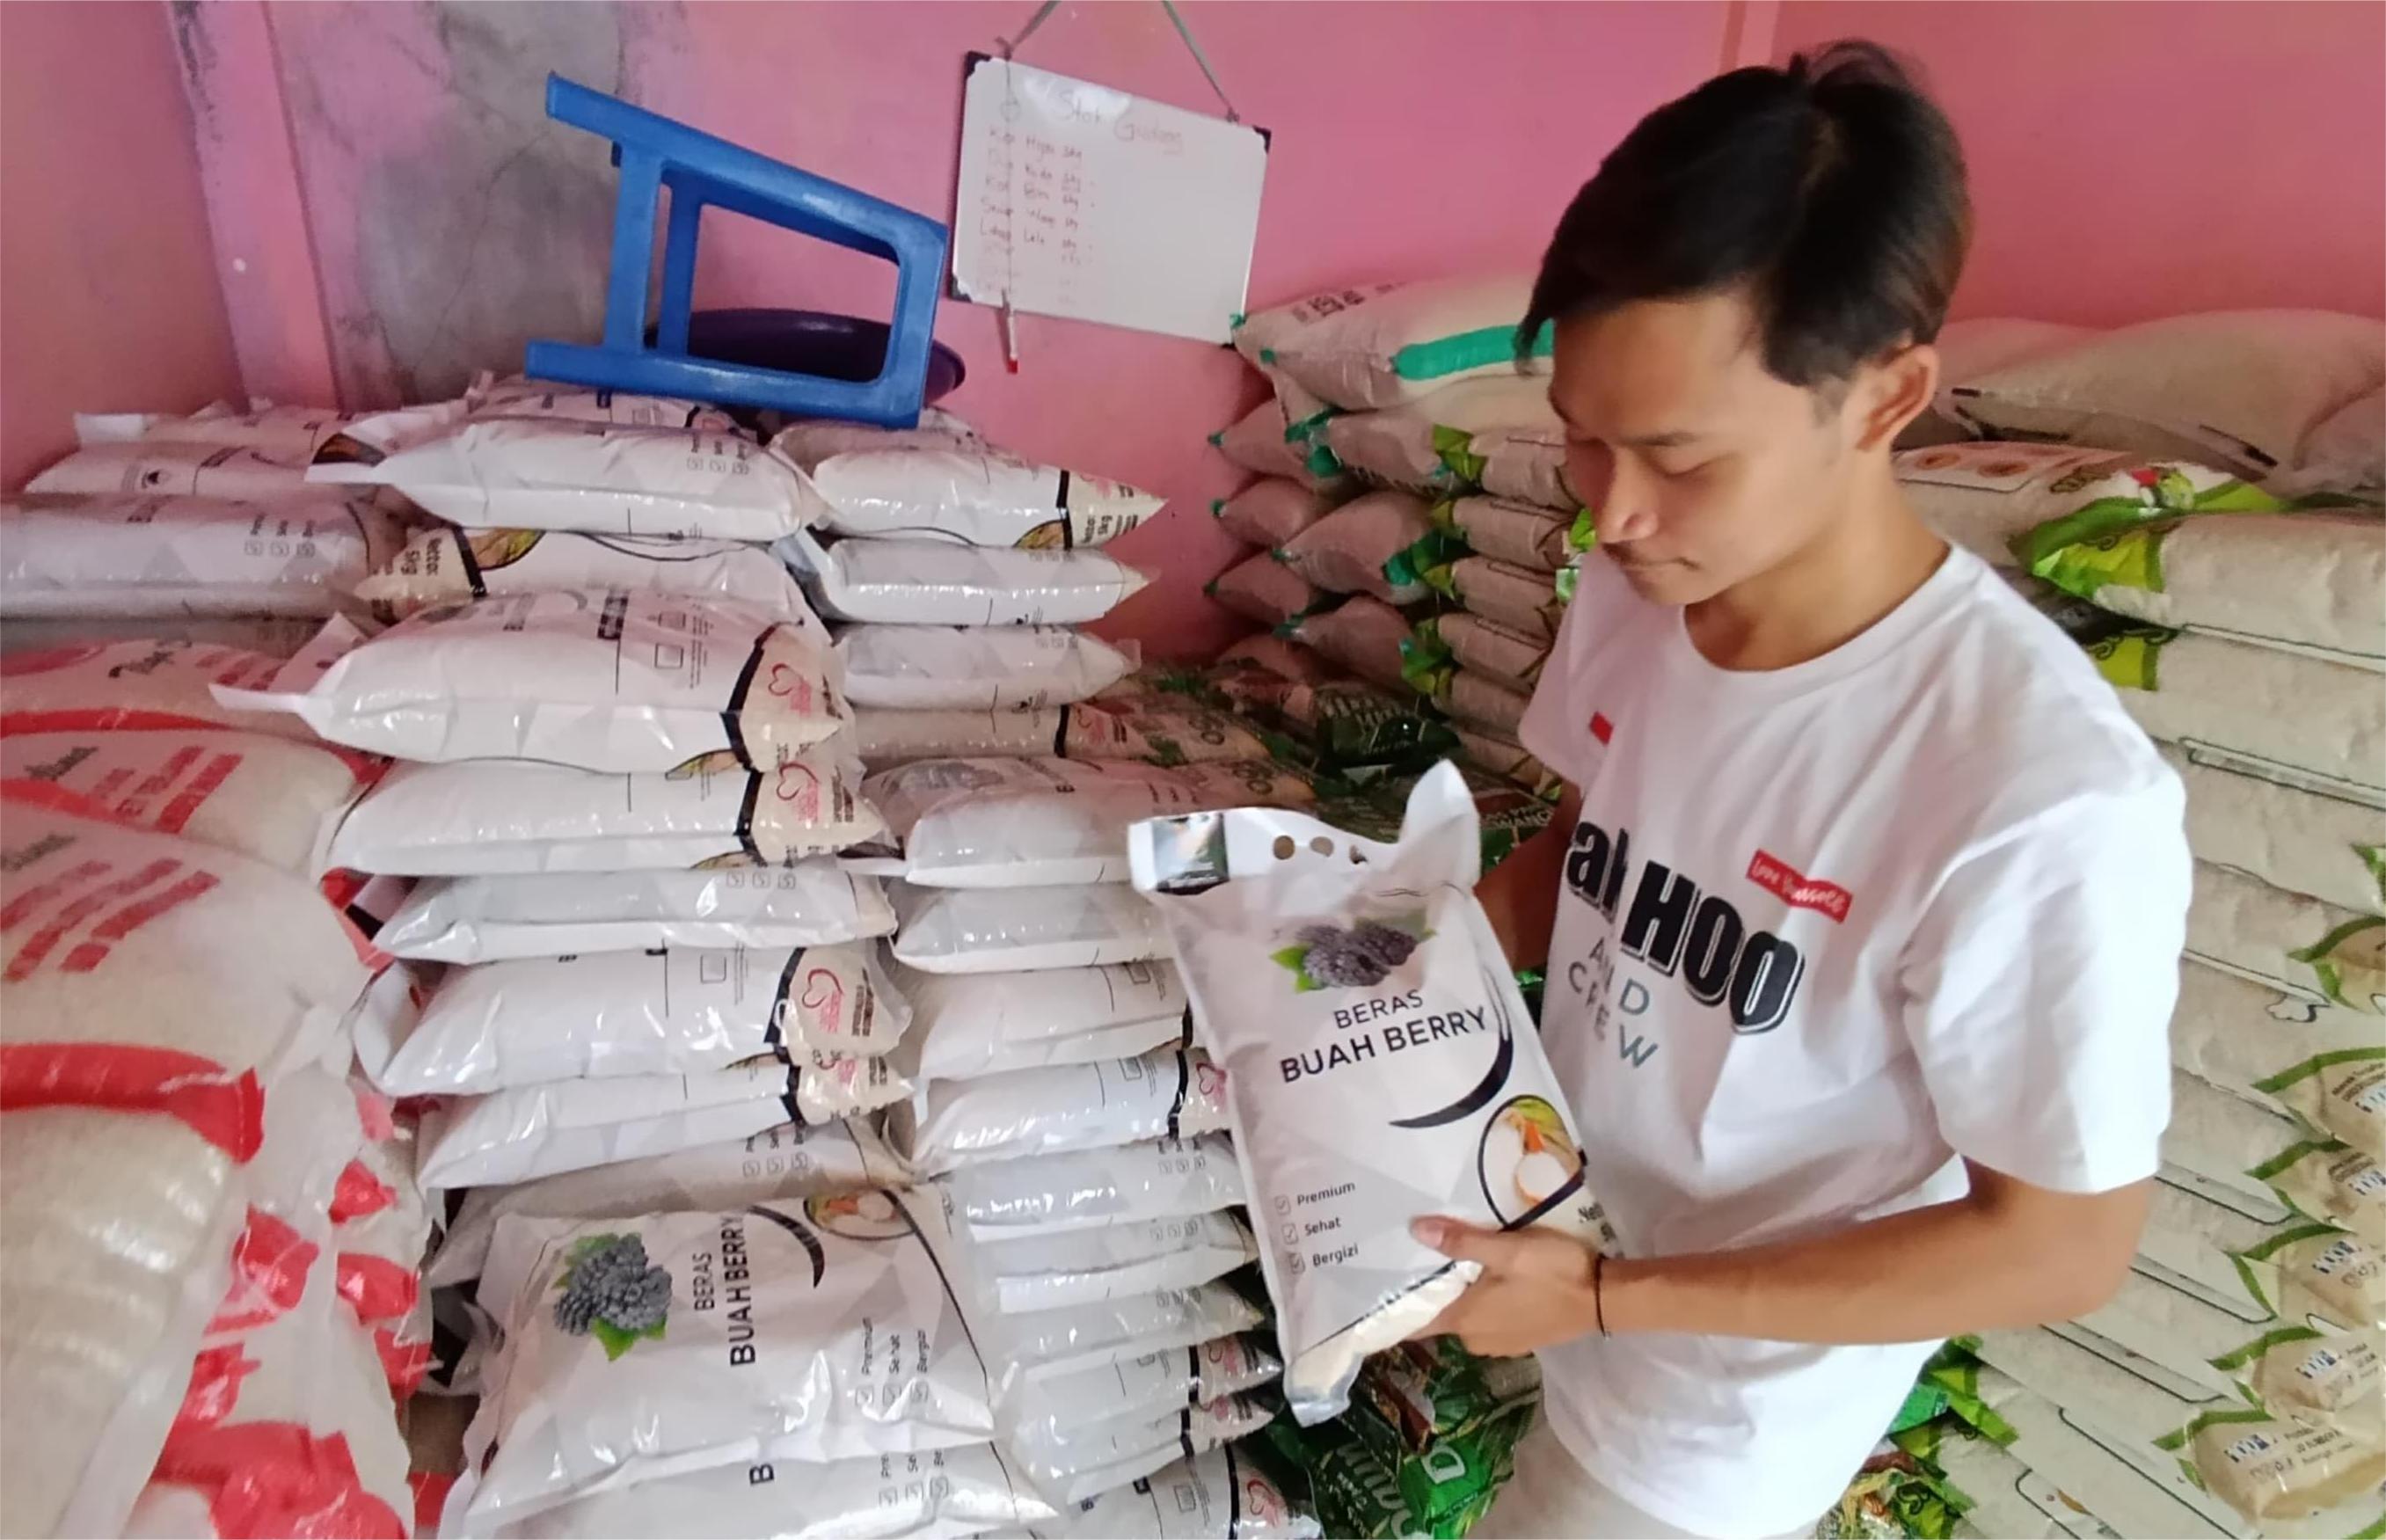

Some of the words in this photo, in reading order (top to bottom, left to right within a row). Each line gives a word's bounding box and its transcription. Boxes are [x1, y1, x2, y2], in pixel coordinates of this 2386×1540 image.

[1333, 989, 1424, 1029] BERAS
[1280, 1033, 1376, 1084] BUAH
[1383, 1006, 1486, 1053] BERRY
[1296, 1182, 1356, 1206] Premium
[1304, 1216, 1341, 1237] Sehat
[720, 1215, 750, 1282] BERRY
[1312, 1243, 1359, 1267] Bergizi
[693, 1252, 715, 1311] BERAS
[726, 1284, 756, 1368] BUAH
[748, 1463, 775, 1485] B
